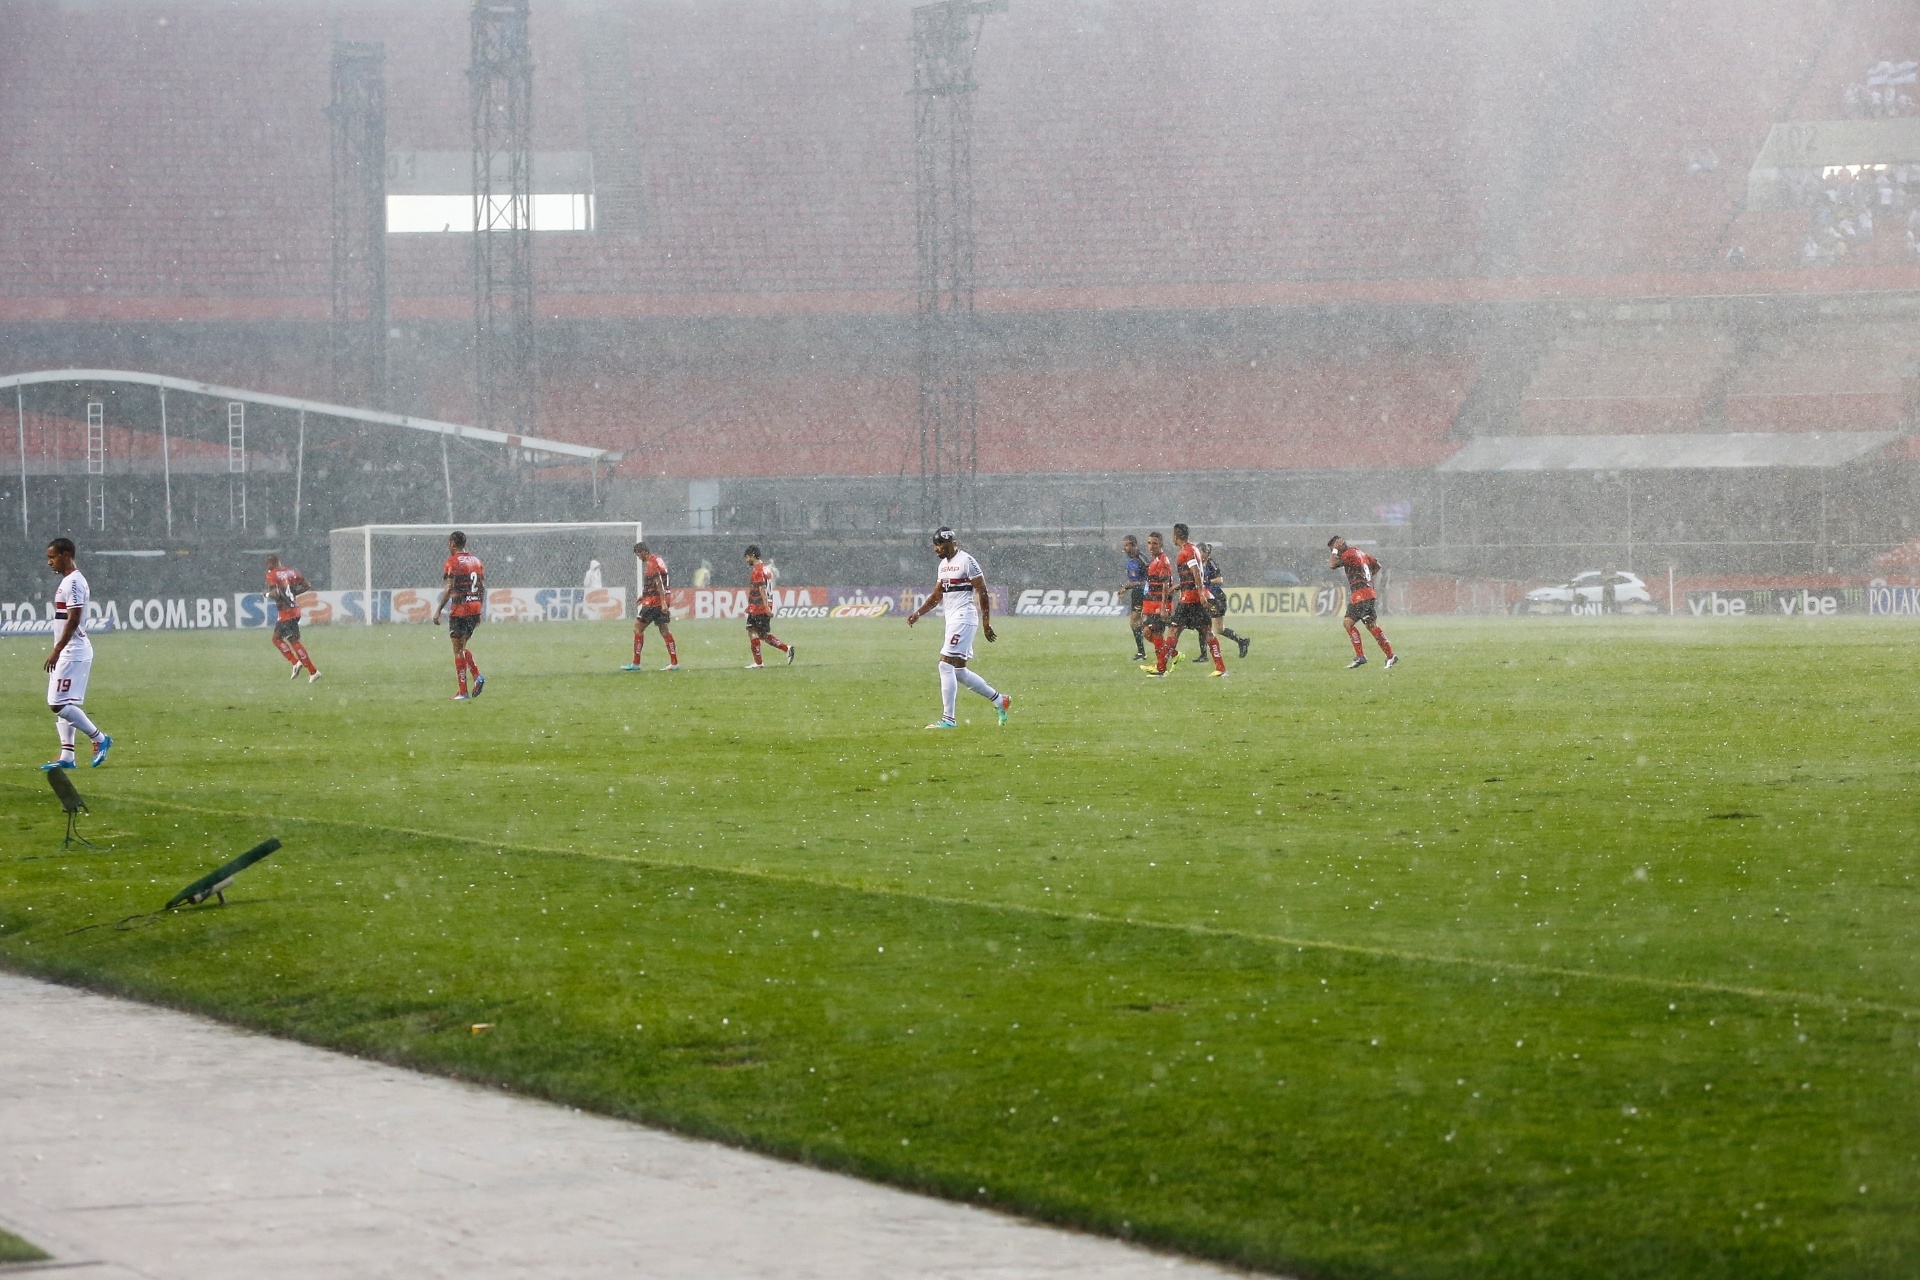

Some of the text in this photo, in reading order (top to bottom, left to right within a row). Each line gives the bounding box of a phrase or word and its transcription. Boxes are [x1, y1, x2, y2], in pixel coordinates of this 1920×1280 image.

[285, 583, 295, 602] 4
[470, 571, 479, 593] 2
[240, 593, 278, 628] Si
[695, 590, 812, 619] BRAMA
[777, 606, 884, 618] SUCOS CAMP
[1228, 592, 1309, 613] OA IDEIA
[1316, 588, 1336, 616] 51
[1570, 603, 1612, 617] ONI
[0, 598, 228, 630] TO DA.COM.BR
[950, 634, 961, 647] 6
[56, 678, 71, 693] 19
